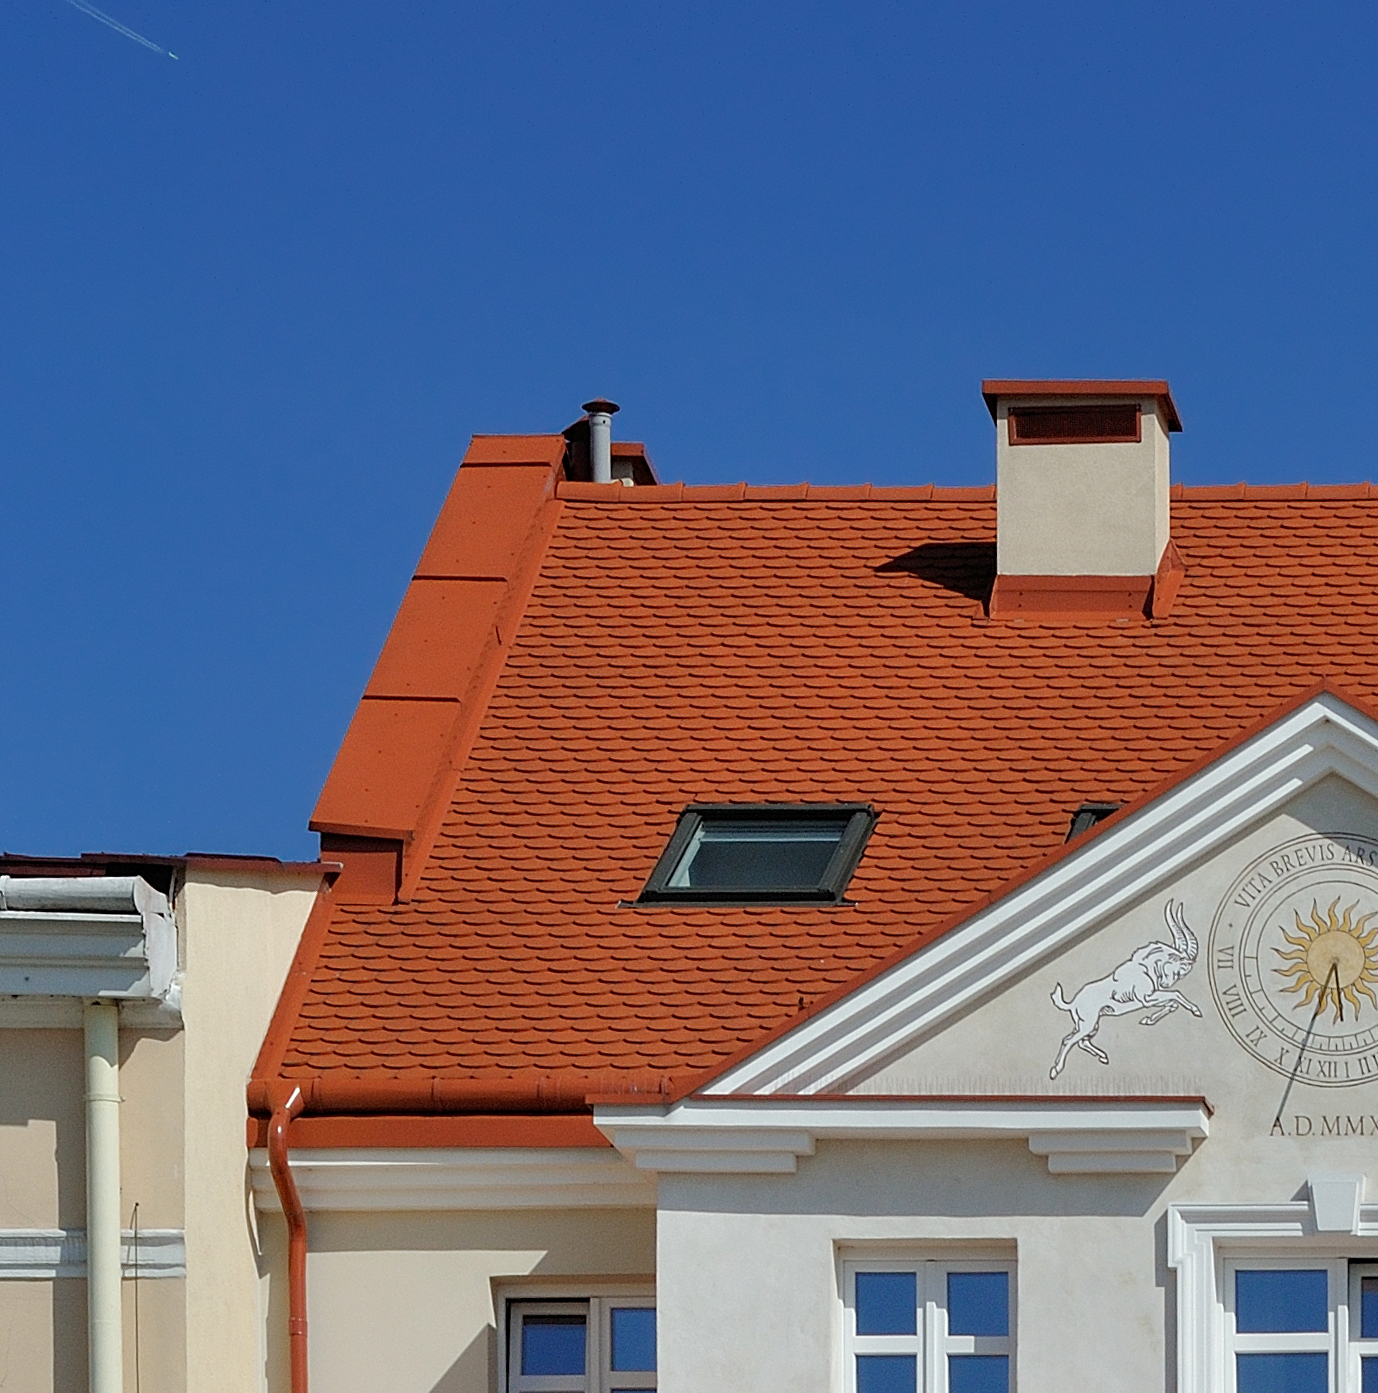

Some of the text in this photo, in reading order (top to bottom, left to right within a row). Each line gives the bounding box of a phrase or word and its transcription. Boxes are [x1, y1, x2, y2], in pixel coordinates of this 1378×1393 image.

[1234, 872, 1274, 909] VITA
[1269, 843, 1336, 879] BREVIS
[1341, 845, 1378, 867] ARS
[1217, 945, 1236, 971] VII
[1222, 984, 1248, 1019] VIII
[1245, 1025, 1268, 1048] IX
[1273, 1046, 1291, 1066] X
[1298, 1056, 1313, 1076] XI
[1316, 1060, 1338, 1079] XII
